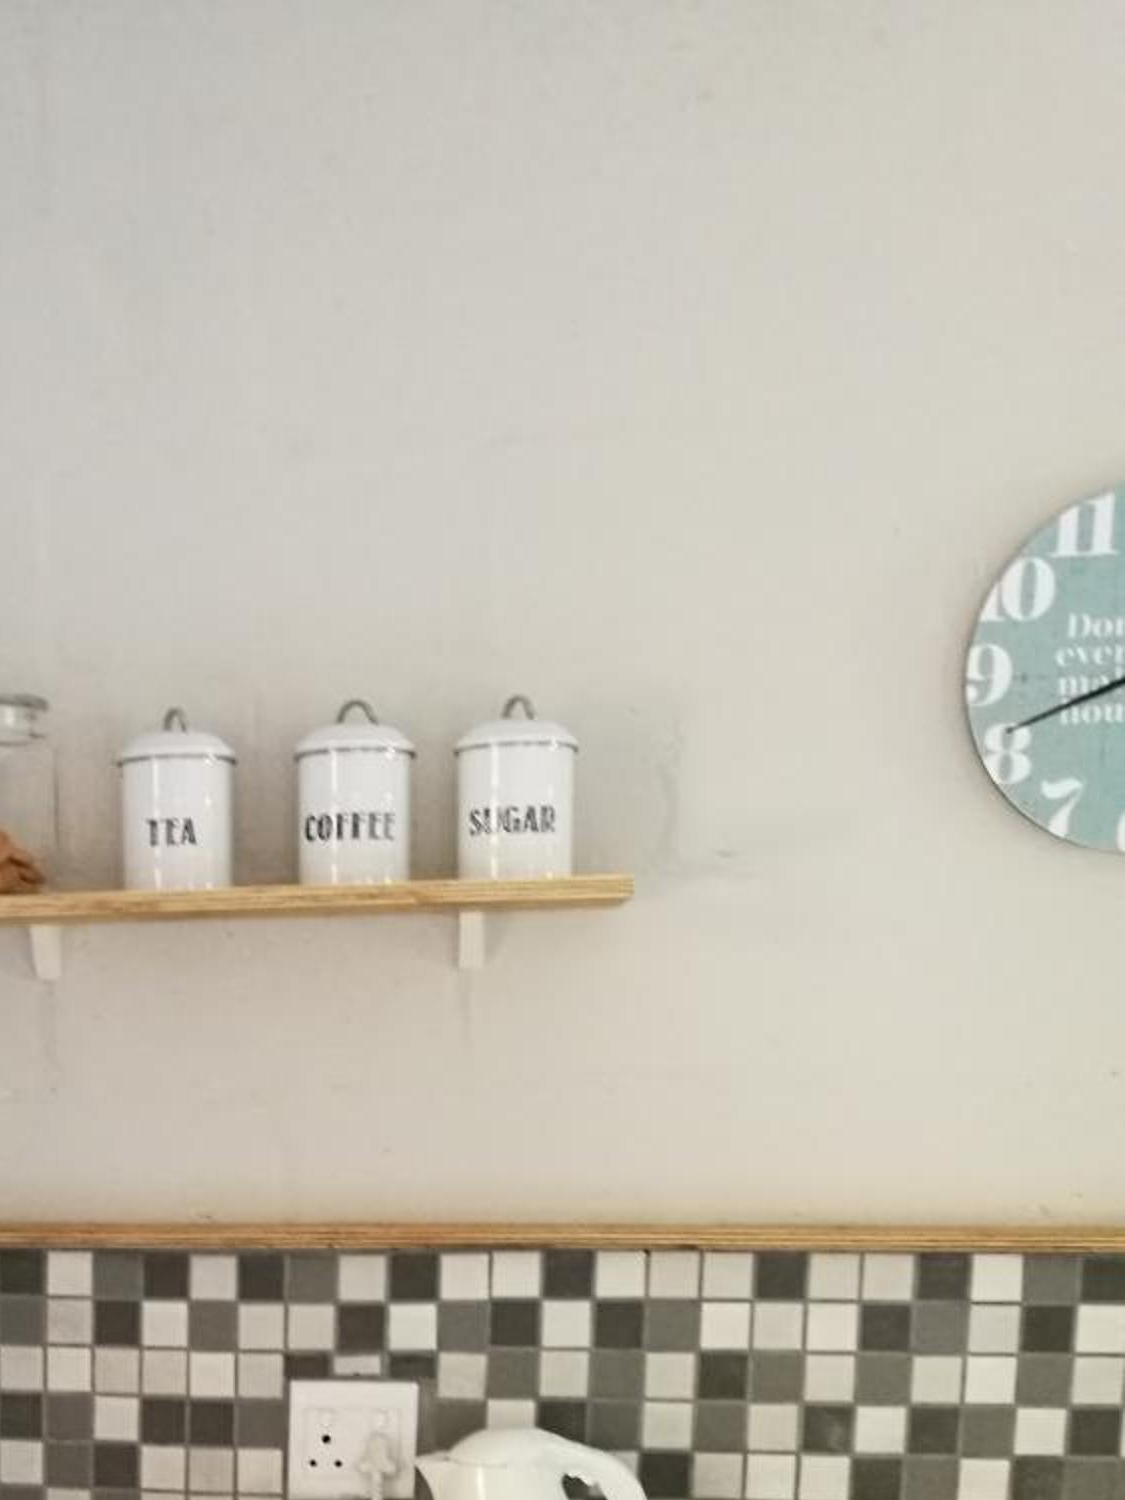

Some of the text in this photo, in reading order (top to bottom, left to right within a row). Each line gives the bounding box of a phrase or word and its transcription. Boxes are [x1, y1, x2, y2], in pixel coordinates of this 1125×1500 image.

[1051, 493, 1117, 557] 11
[966, 643, 1013, 707] 9
[984, 723, 1033, 785] 8
[144, 817, 197, 847] TEA
[304, 811, 395, 842] COFFEE
[470, 805, 555, 837] SUGAR
[1041, 777, 1084, 838] 7
